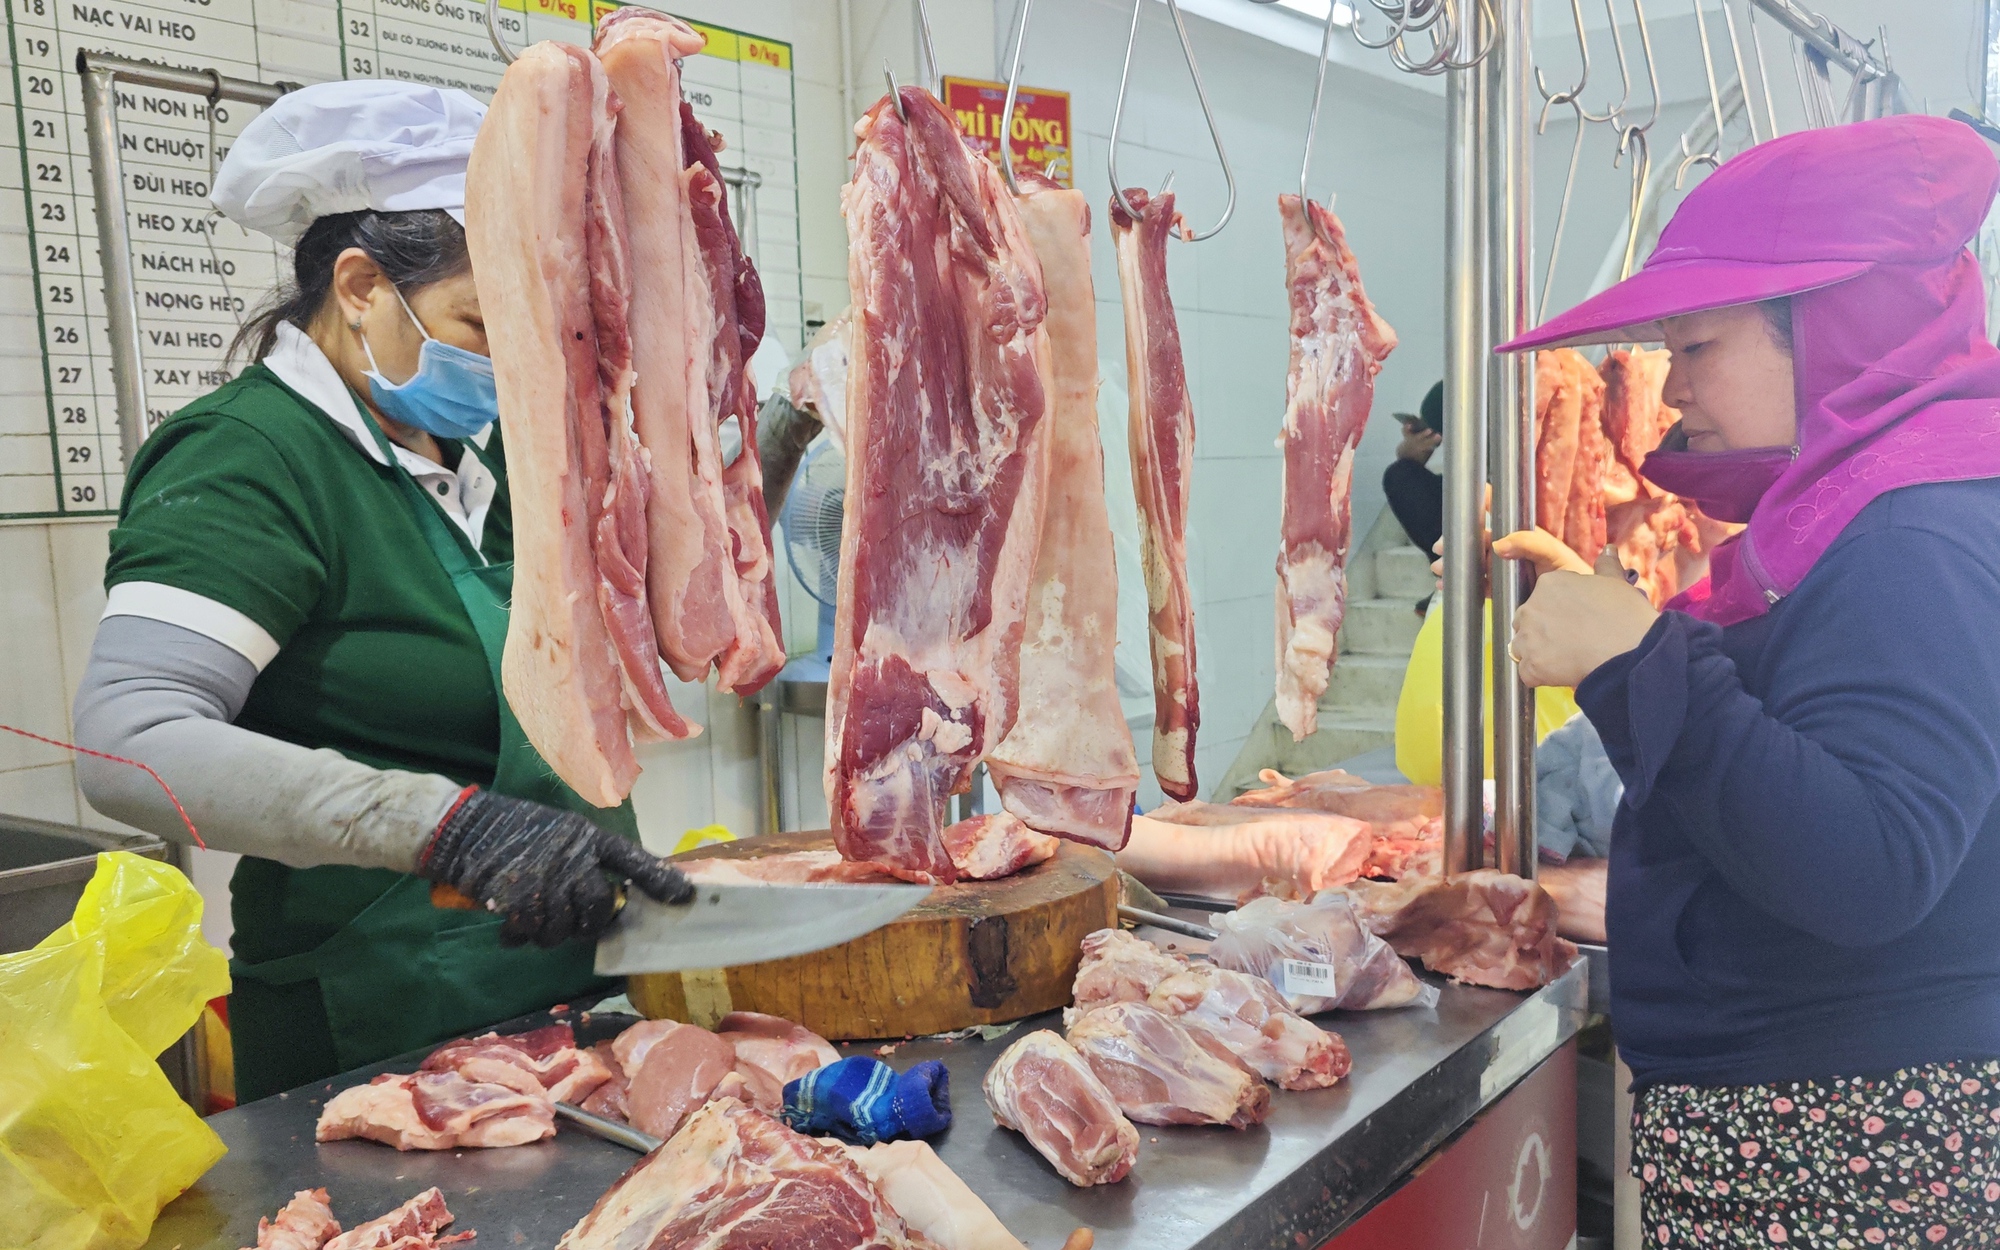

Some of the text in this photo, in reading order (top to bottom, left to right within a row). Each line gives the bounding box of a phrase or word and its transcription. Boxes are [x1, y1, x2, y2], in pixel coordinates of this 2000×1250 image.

[23, 0, 196, 42] 18 NẠC VAI HEO
[349, 20, 370, 38] 32
[26, 38, 50, 58] 19
[353, 57, 373, 76] 33
[28, 76, 54, 96] 20
[143, 96, 187, 118] NON
[32, 120, 56, 138] 21
[144, 136, 204, 162] CHUỘT
[36, 163, 208, 198] 22 ĐÙI HEO
[40, 203, 217, 236] 23 HEO XAY
[45, 246, 236, 276] 24 NÁCH HEO
[49, 286, 245, 313] 25 NỌNG HEO
[54, 327, 223, 348] 26 VAI HEO
[58, 367, 82, 384] 27
[153, 369, 191, 385] XAY
[63, 407, 87, 424] 28
[67, 447, 91, 463] 29
[71, 486, 96, 503] 30
